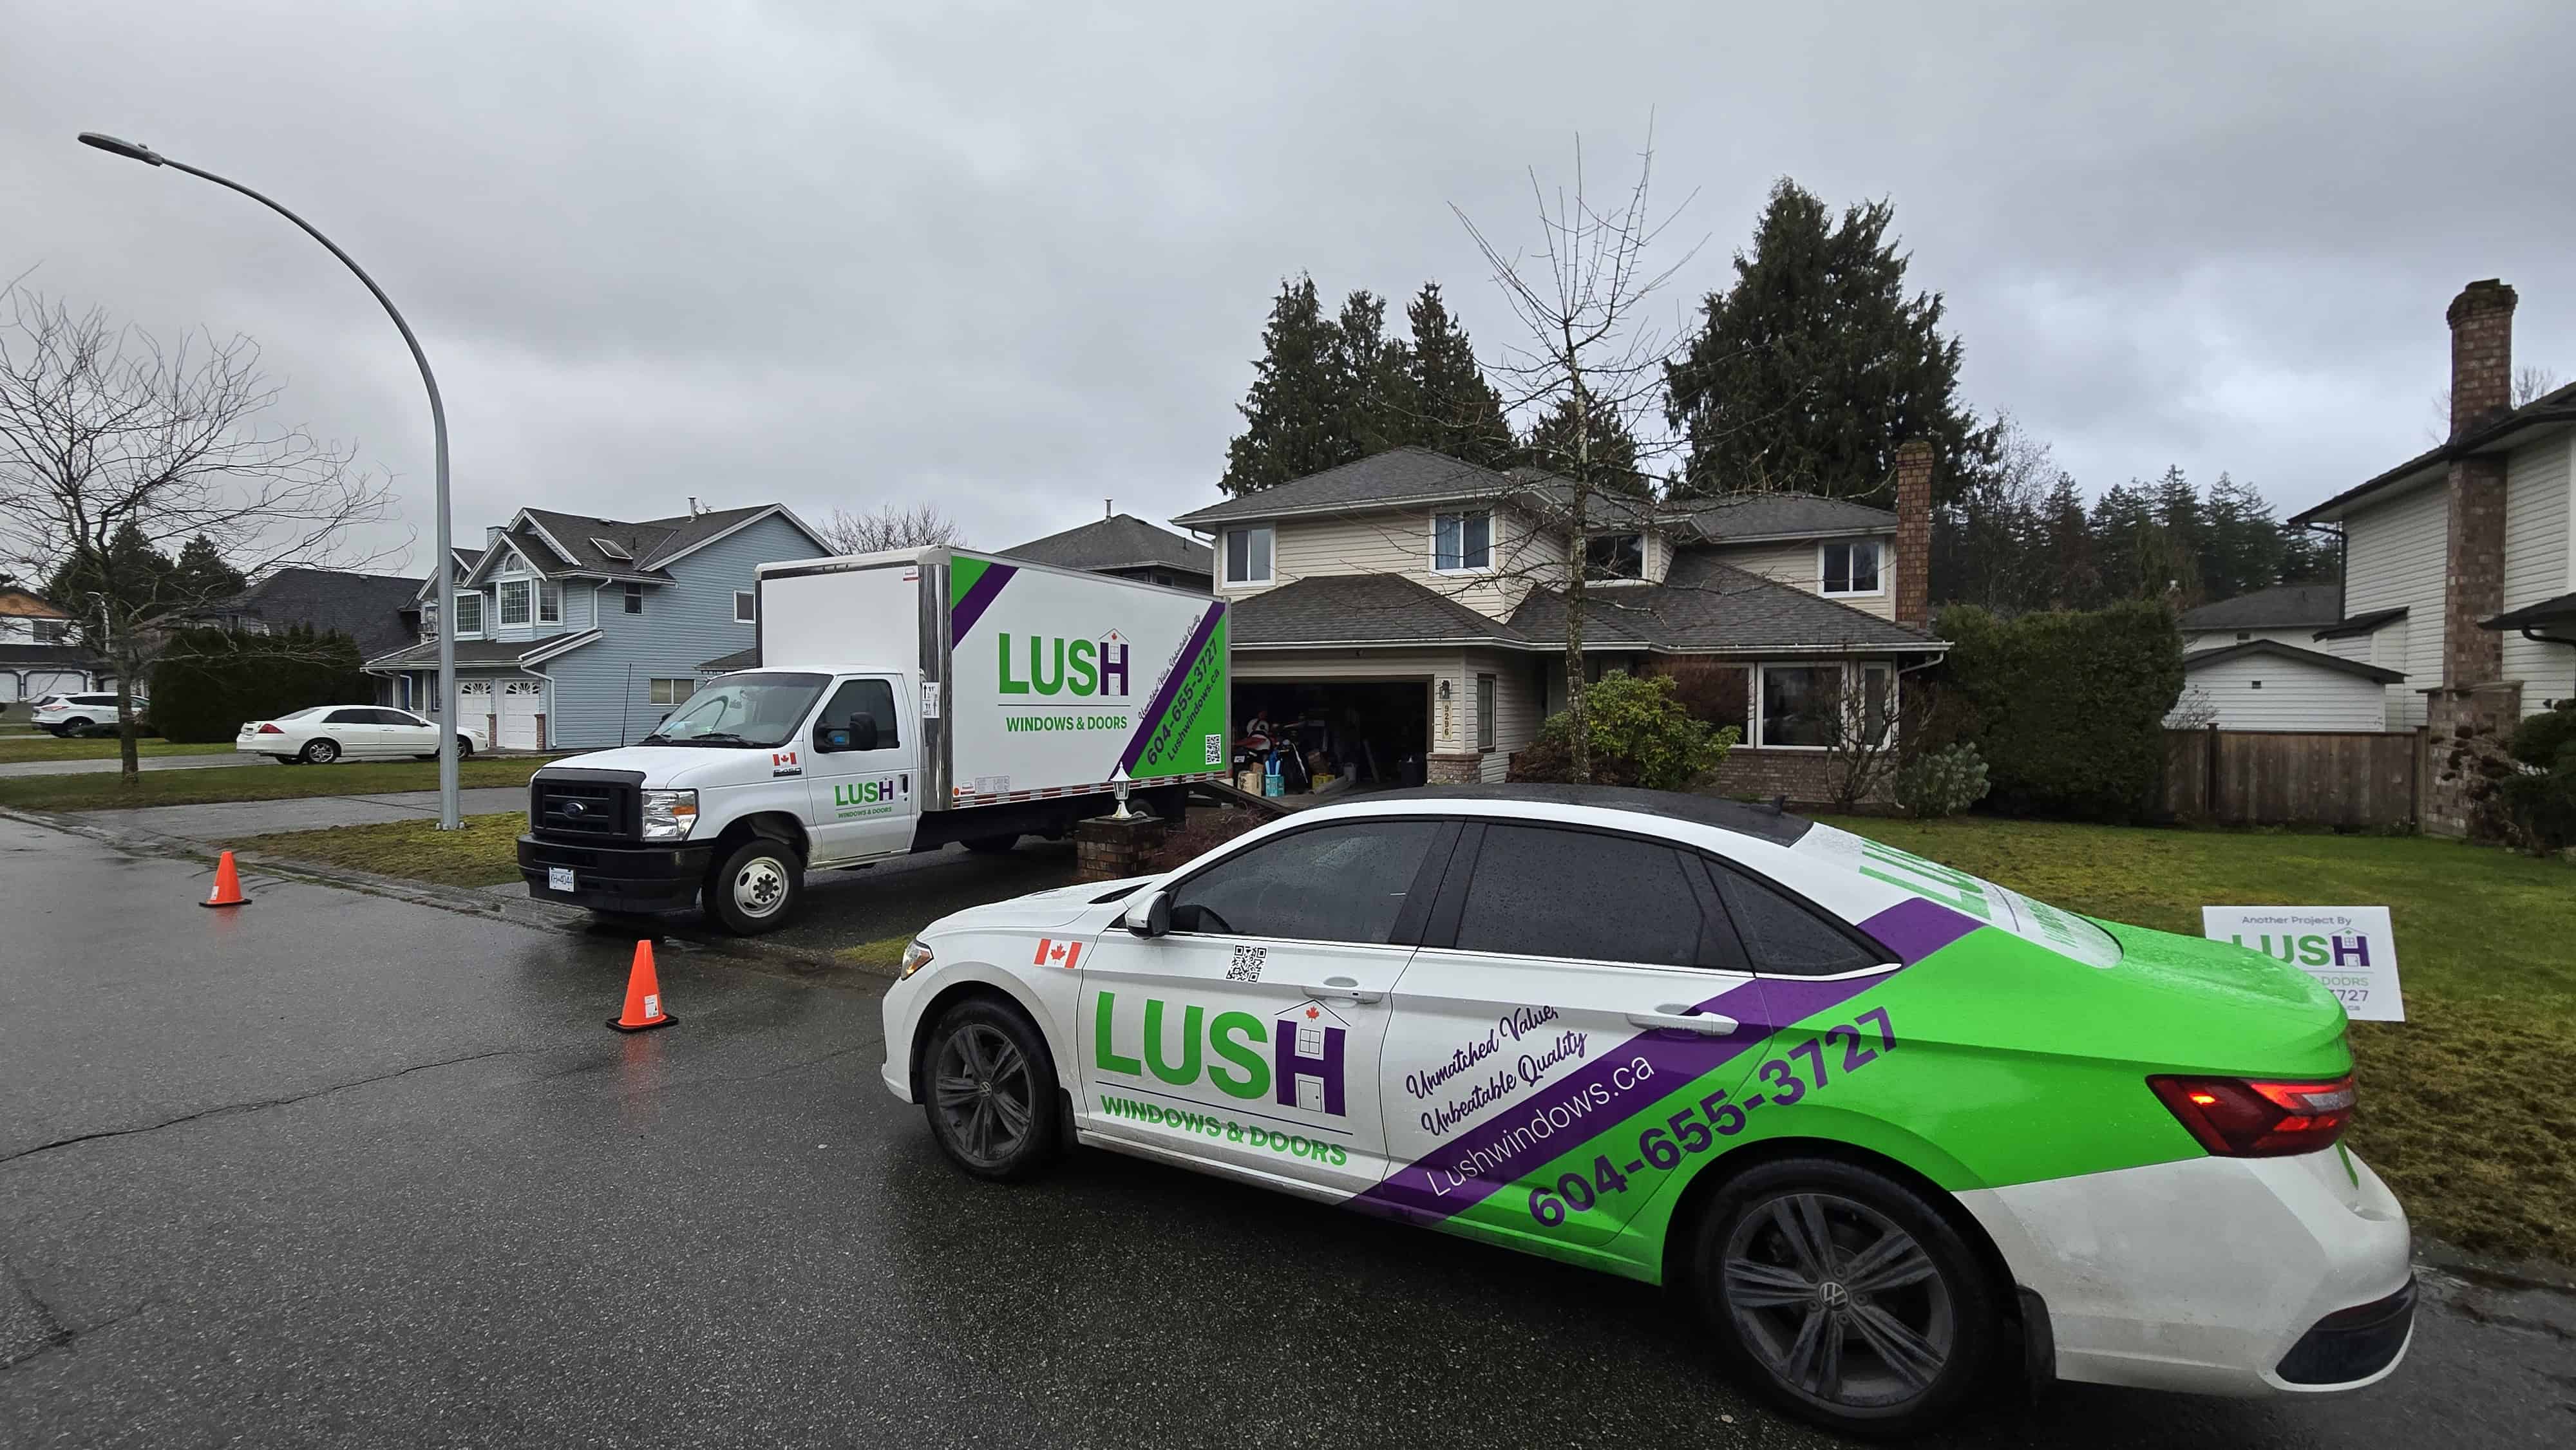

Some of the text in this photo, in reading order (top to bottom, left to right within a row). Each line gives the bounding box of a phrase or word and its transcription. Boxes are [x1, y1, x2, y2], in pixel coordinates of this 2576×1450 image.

[999, 632, 1128, 696] LUSH
[1006, 715, 1127, 732] WINDOWS & DOORS
[1147, 637, 1217, 765] 604-655-3727
[1167, 668, 1220, 761] Lushwindows.ca
[835, 780, 893, 806] LUSH
[838, 809, 866, 819] WINDOWS
[2291, 916, 2334, 926] Project
[2338, 916, 2352, 926] By
[2321, 976, 2369, 987] DOORS
[1095, 992, 1346, 1117] LUSH
[1406, 1029, 1499, 1099] Unmatched
[1421, 1030, 1587, 1136] Unbeatable Quality
[1100, 1095, 1347, 1166] WINDOWS & DOORS
[1426, 1054, 1654, 1196] Lushwindows.ca
[1528, 1007, 1898, 1227] 604-655-3727
